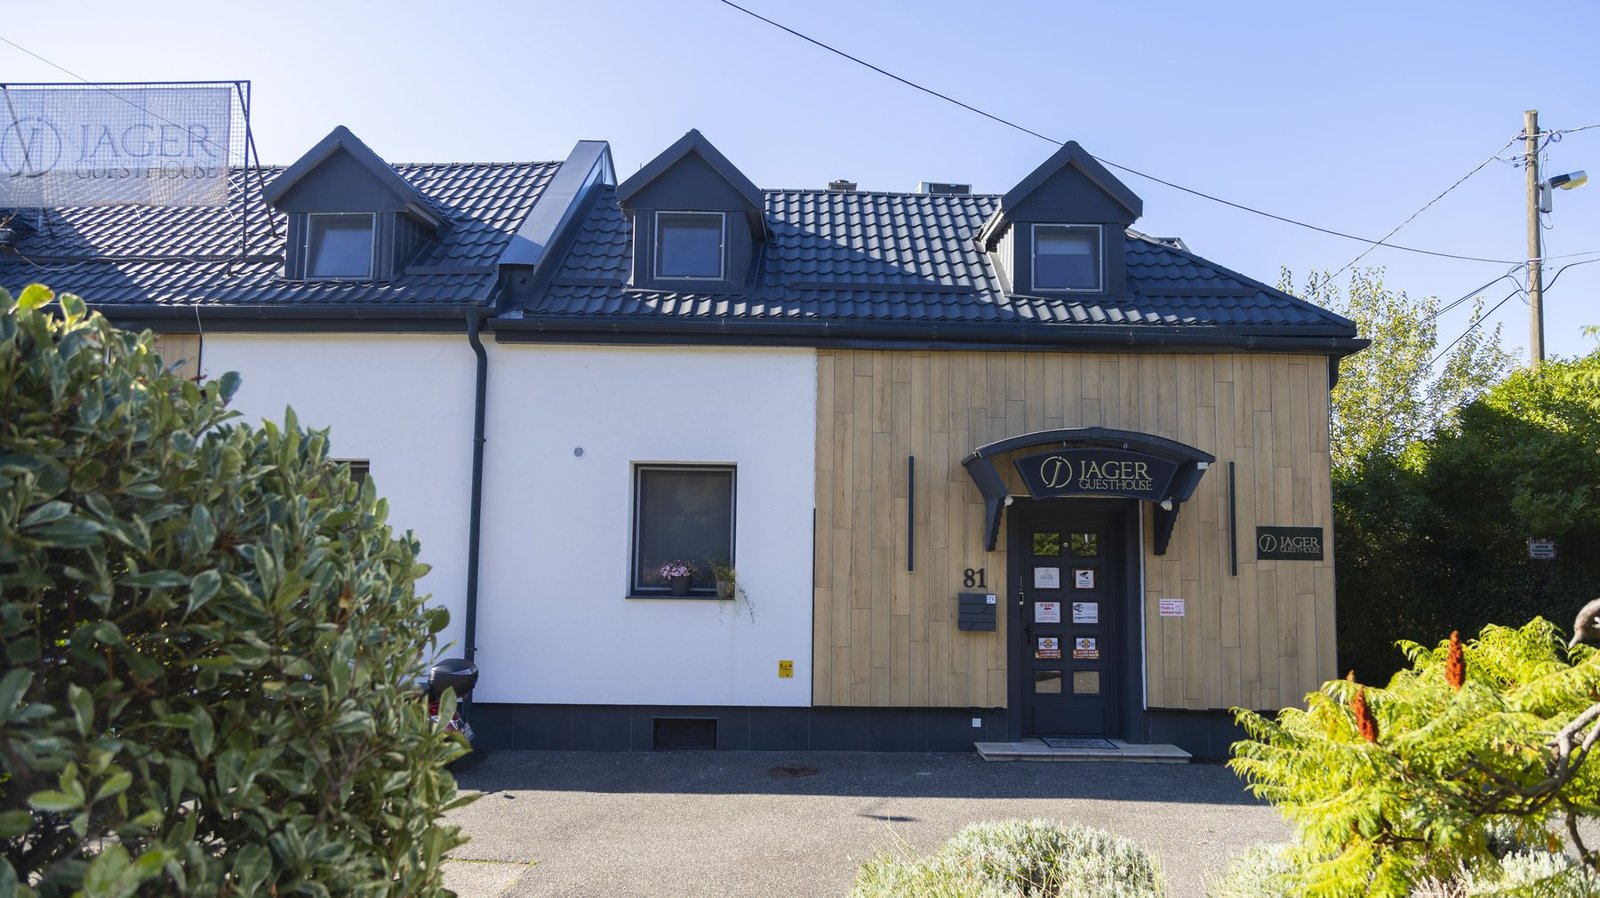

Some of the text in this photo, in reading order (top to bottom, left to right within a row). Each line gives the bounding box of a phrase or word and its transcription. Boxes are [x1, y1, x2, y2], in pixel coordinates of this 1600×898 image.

[76, 123, 217, 160] JAGER
[75, 159, 218, 180] GUESTHOUSE
[1079, 460, 1152, 480] JAGER
[1078, 479, 1152, 491] GUESTHOUSE
[1280, 536, 1320, 548] JAGER
[1280, 546, 1320, 554] GUESTHOUSE
[963, 568, 987, 588] 81
